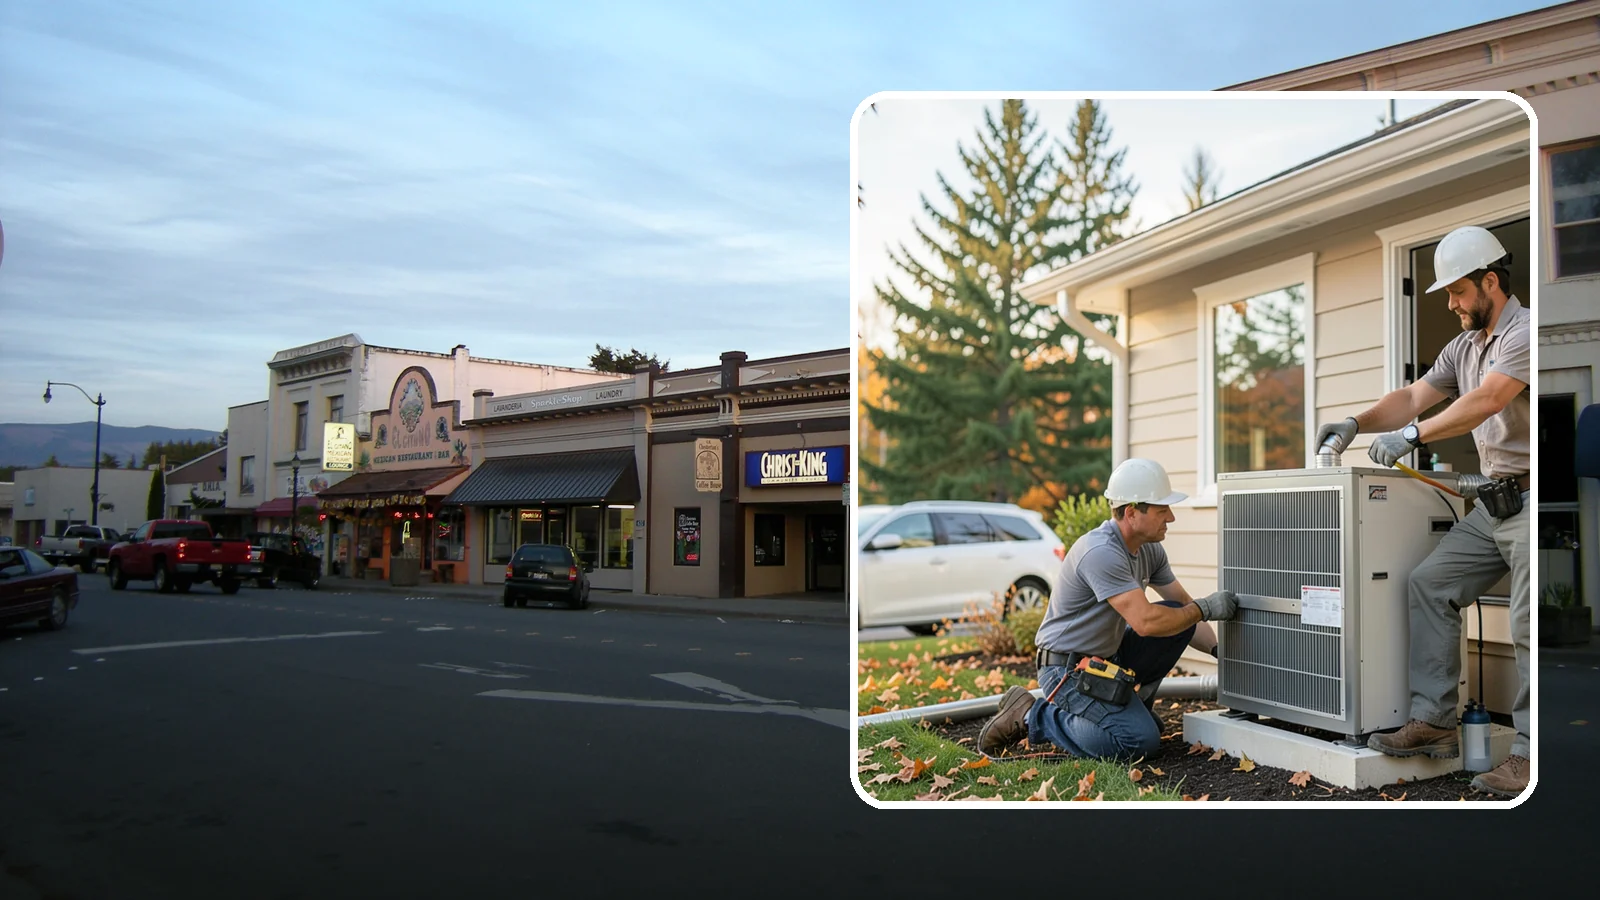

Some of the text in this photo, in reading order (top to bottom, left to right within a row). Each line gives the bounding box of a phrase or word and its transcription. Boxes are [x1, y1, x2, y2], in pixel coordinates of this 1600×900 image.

[561, 394, 582, 404] Shop
[595, 389, 623, 400] LAUNDRY
[493, 402, 522, 412] LAVANDERIA
[373, 455, 396, 464] MEXICAN
[398, 451, 433, 462] RESTAURANT
[438, 450, 449, 458] BAR
[761, 450, 827, 477] CHRIST KING
